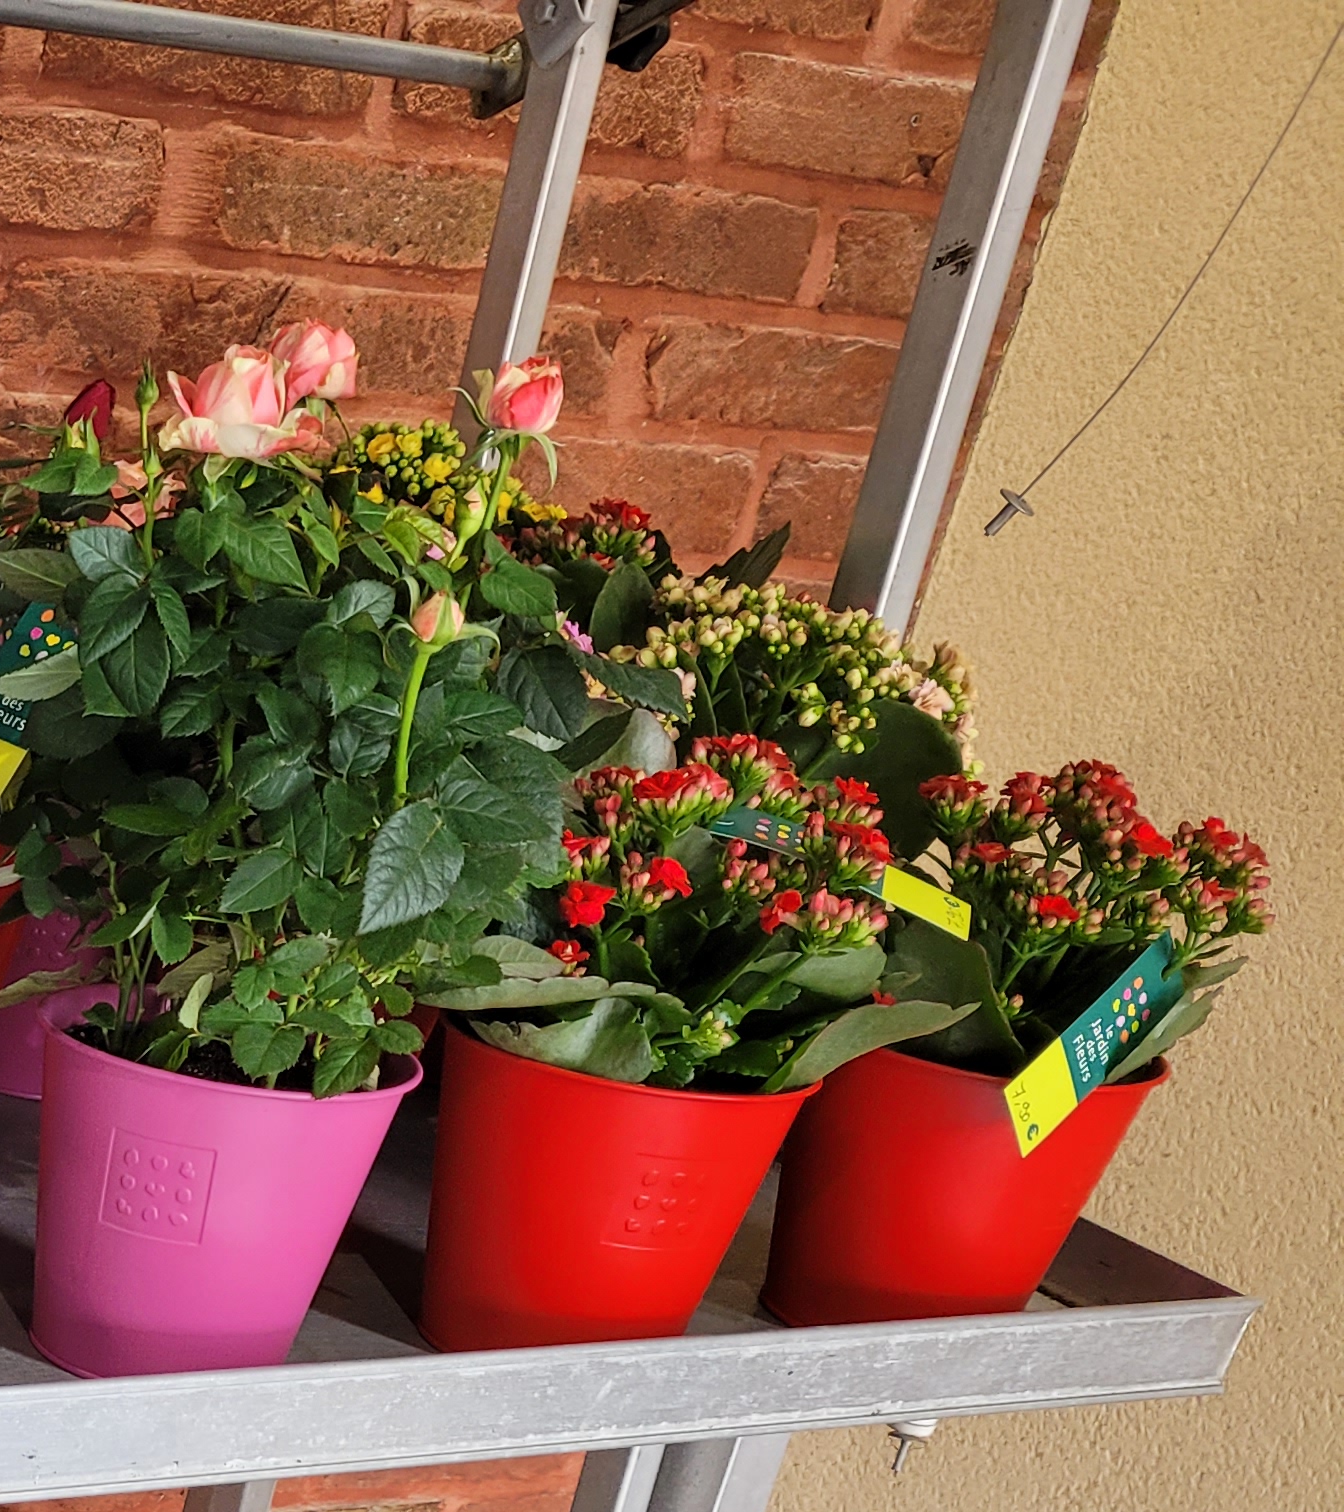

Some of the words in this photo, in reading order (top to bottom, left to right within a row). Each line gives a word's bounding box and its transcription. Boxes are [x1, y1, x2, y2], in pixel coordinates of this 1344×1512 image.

[1090, 1018, 1109, 1065] Jardin
[1105, 1022, 1114, 1040] le
[1072, 1033, 1092, 1083] Fleurs
[1086, 1040, 1097, 1062] des
[1026, 1122, 1039, 1142] €
